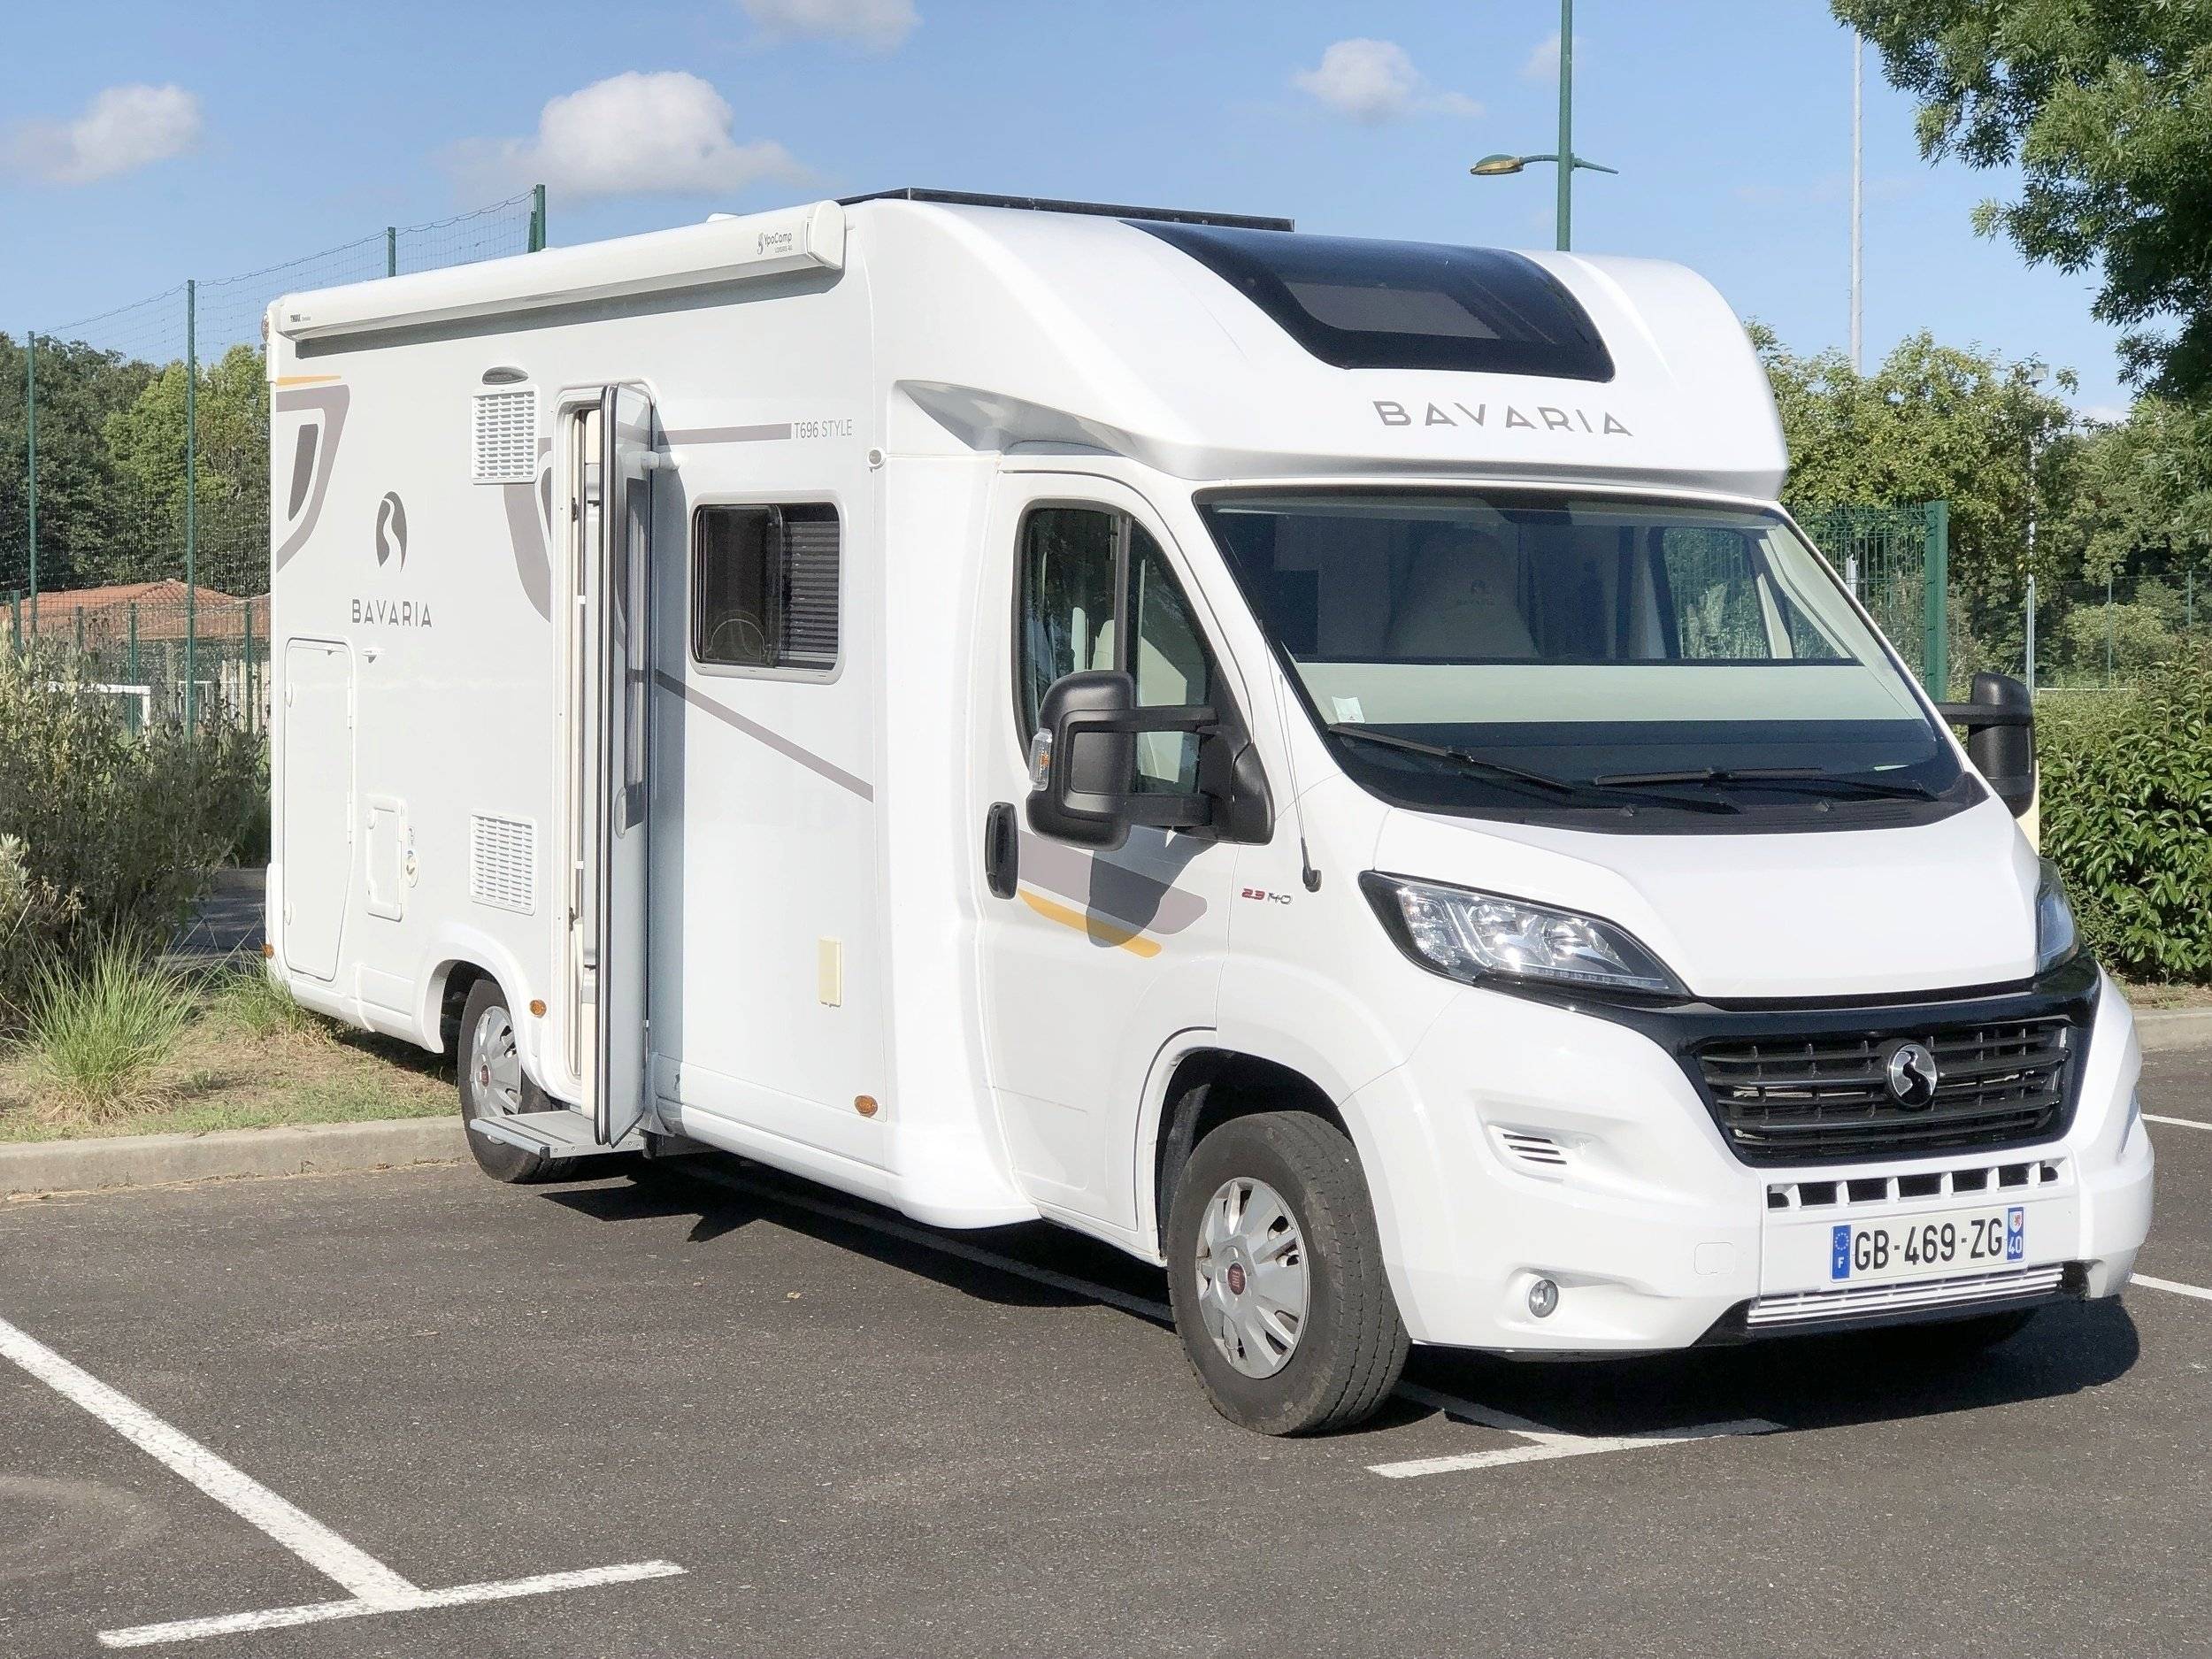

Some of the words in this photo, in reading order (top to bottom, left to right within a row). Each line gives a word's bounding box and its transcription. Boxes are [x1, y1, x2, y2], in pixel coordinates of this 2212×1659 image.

[795, 421, 819, 439] T696
[821, 419, 853, 437] STYLE
[1372, 400, 1634, 437] BAVARIA
[352, 599, 432, 627] BAVARIA
[1855, 1217, 2002, 1271] GB-469-ZG
[2008, 1235, 2023, 1255] 40
[1838, 1256, 1845, 1269] F
